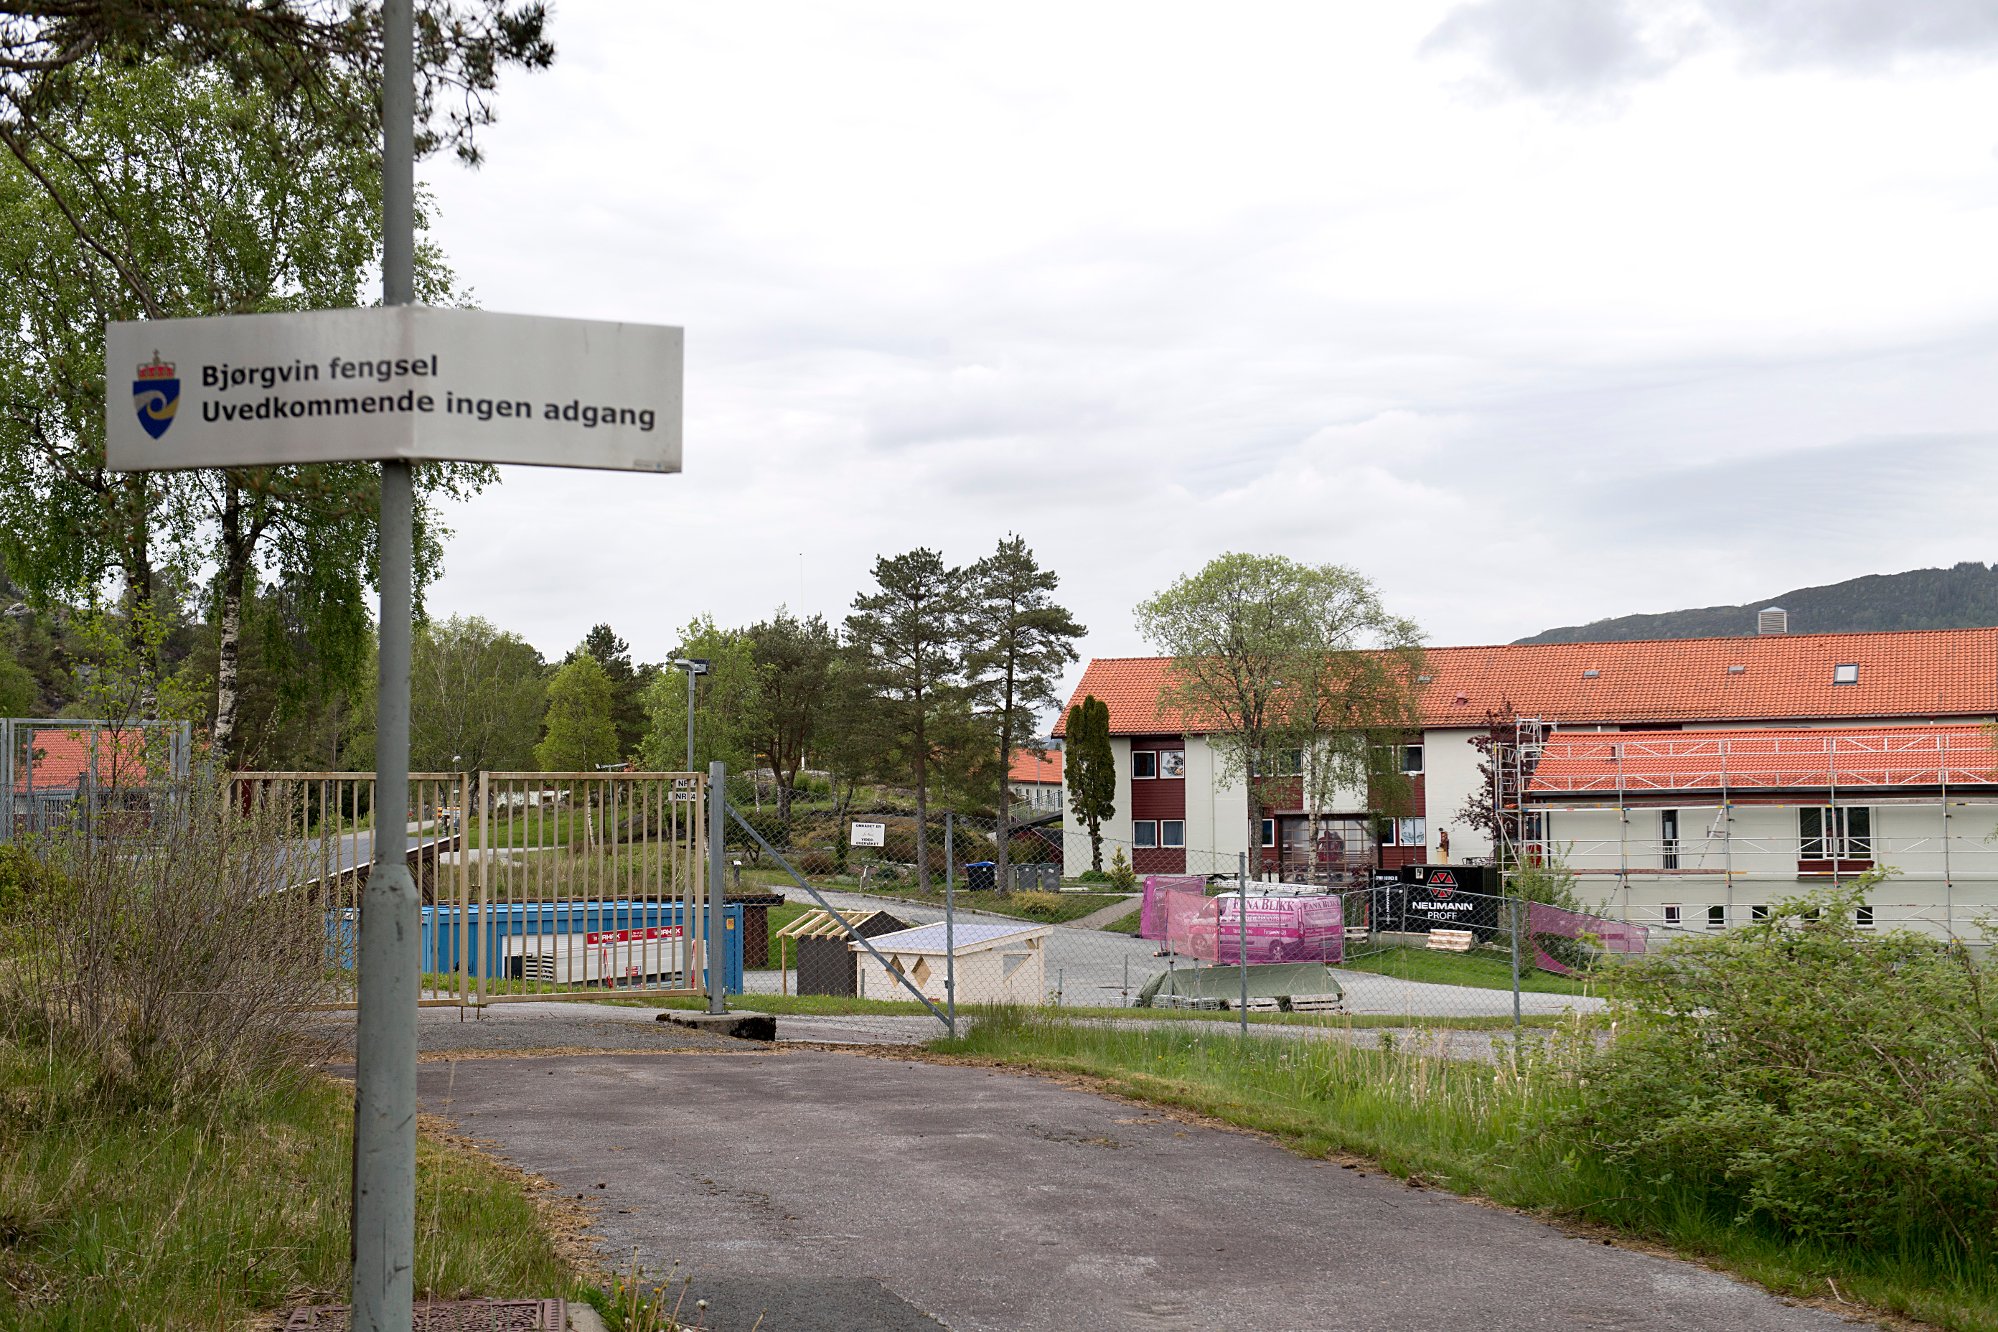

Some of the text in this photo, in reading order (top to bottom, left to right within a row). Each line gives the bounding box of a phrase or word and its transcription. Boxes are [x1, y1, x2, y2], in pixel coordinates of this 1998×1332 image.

[202, 354, 438, 392] Bjørgvin fengsel
[202, 389, 655, 432] Uvedkommende ingen adgang
[1233, 898, 1295, 911] FNA BLIKK
[1412, 901, 1473, 911] NEUMANN
[1427, 911, 1458, 920] PROFF
